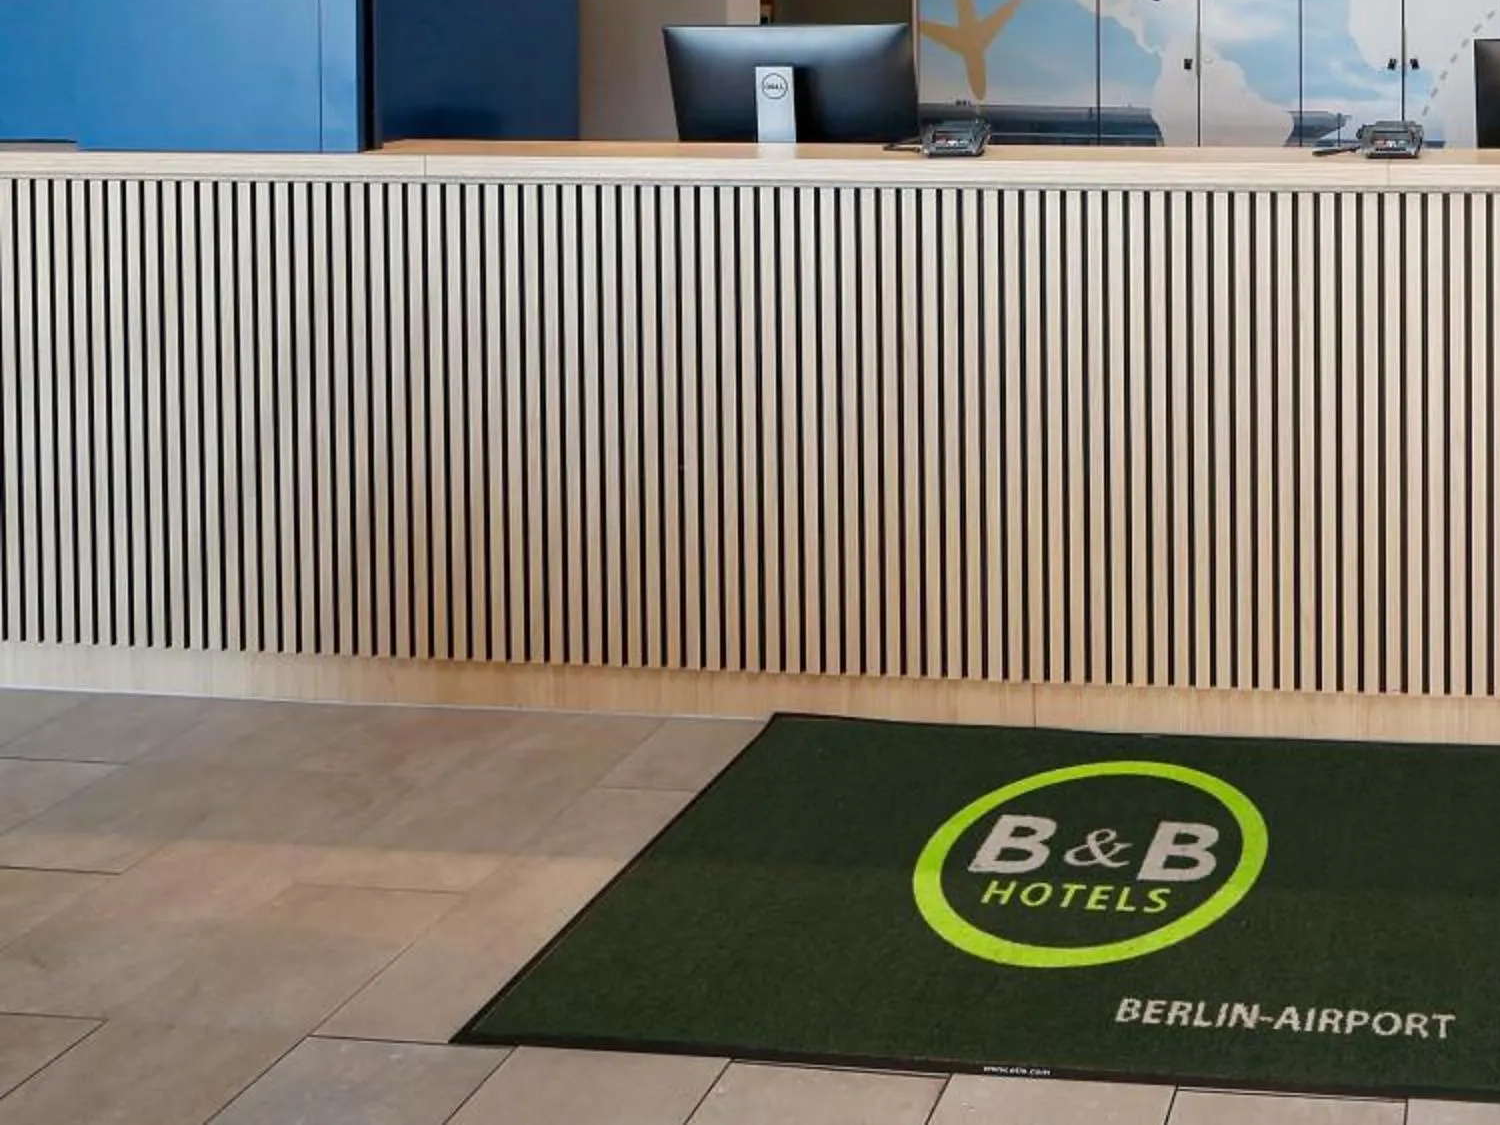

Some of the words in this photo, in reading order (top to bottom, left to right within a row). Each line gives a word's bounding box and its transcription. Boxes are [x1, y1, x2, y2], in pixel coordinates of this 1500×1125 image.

[968, 813, 1220, 883] B&B
[979, 879, 1172, 915] HOTELS
[1115, 997, 1456, 1040] BERLIN-AIRPORT
